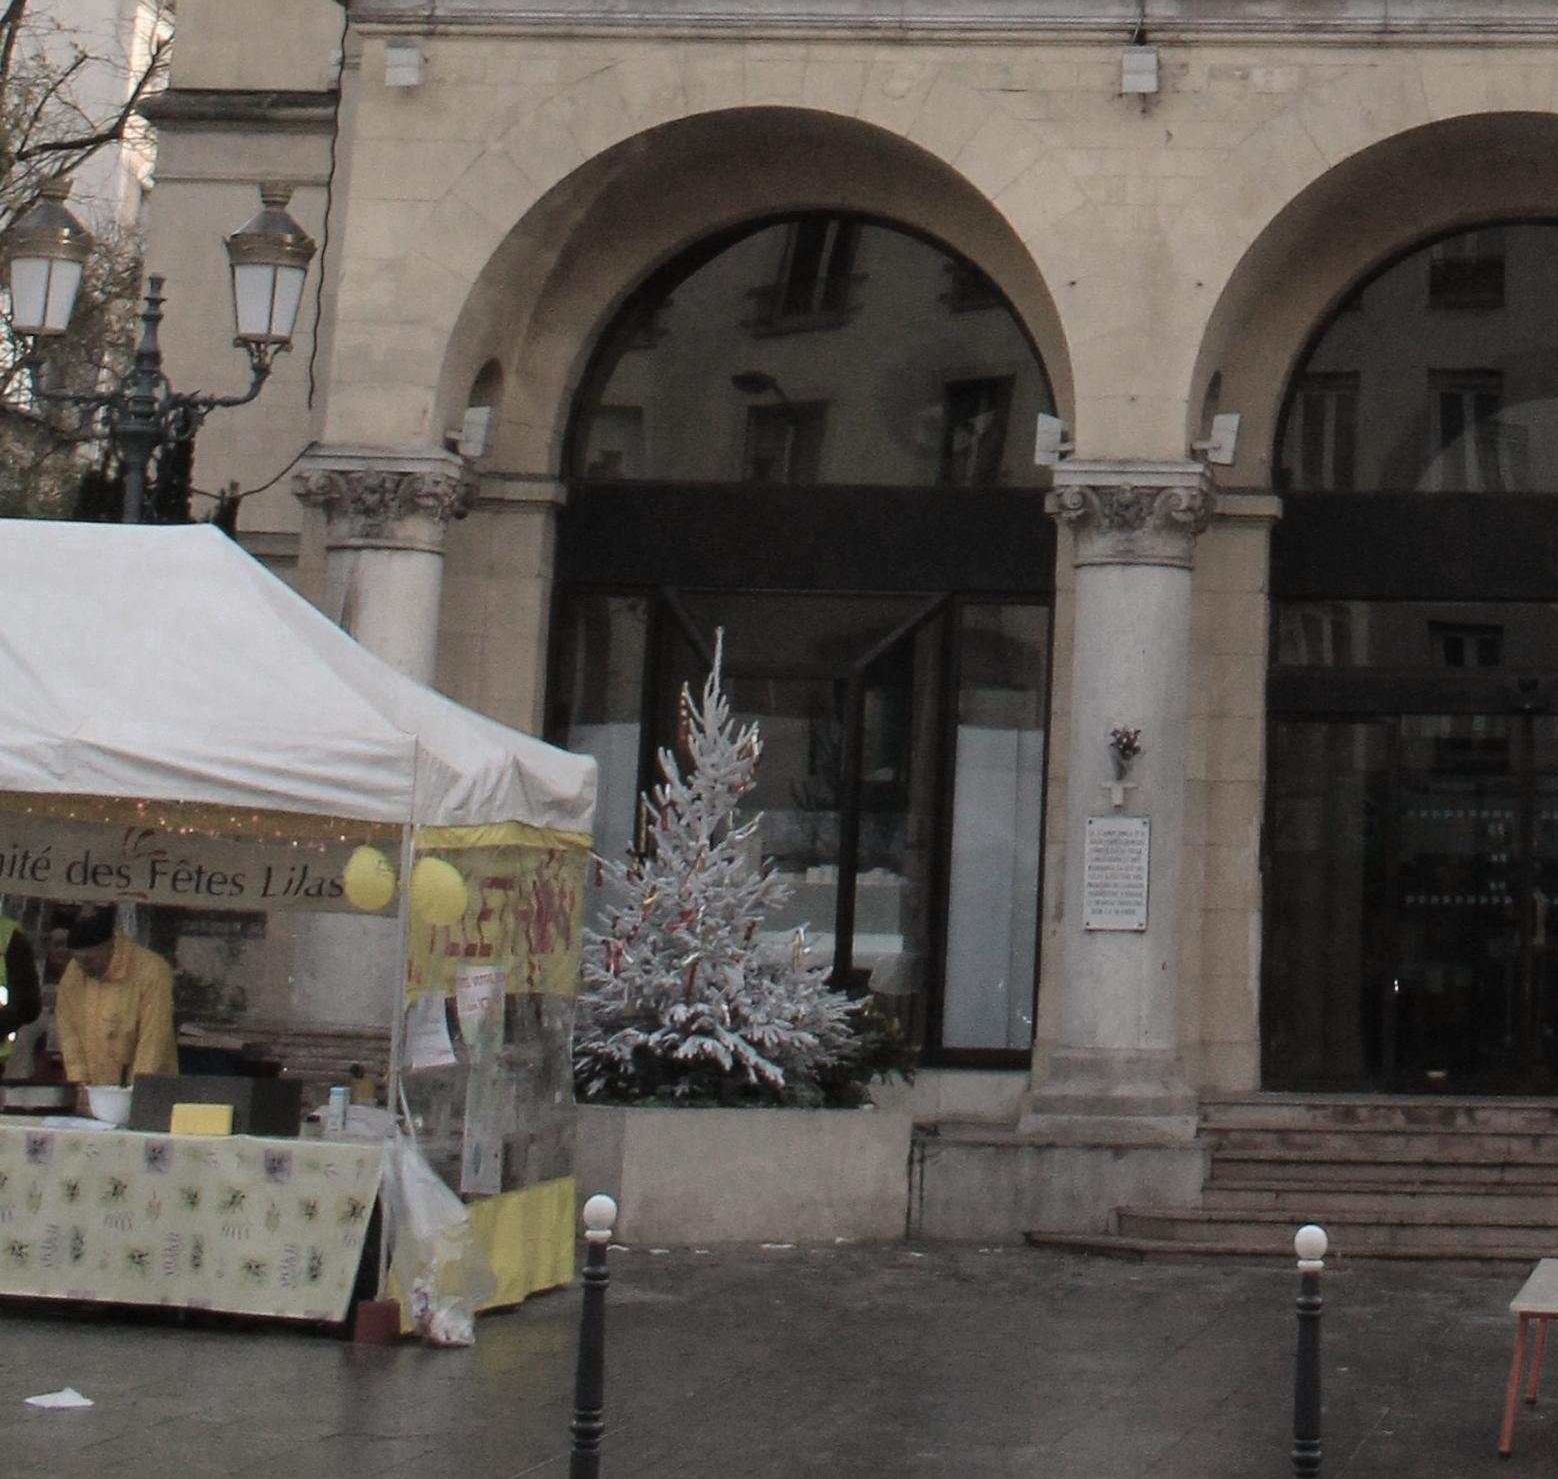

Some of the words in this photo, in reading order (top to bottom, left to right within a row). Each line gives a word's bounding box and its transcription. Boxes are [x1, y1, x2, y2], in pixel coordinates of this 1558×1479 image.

[66, 851, 131, 888] des
[150, 859, 246, 897] Fêtes
[262, 864, 345, 899] Lilas
